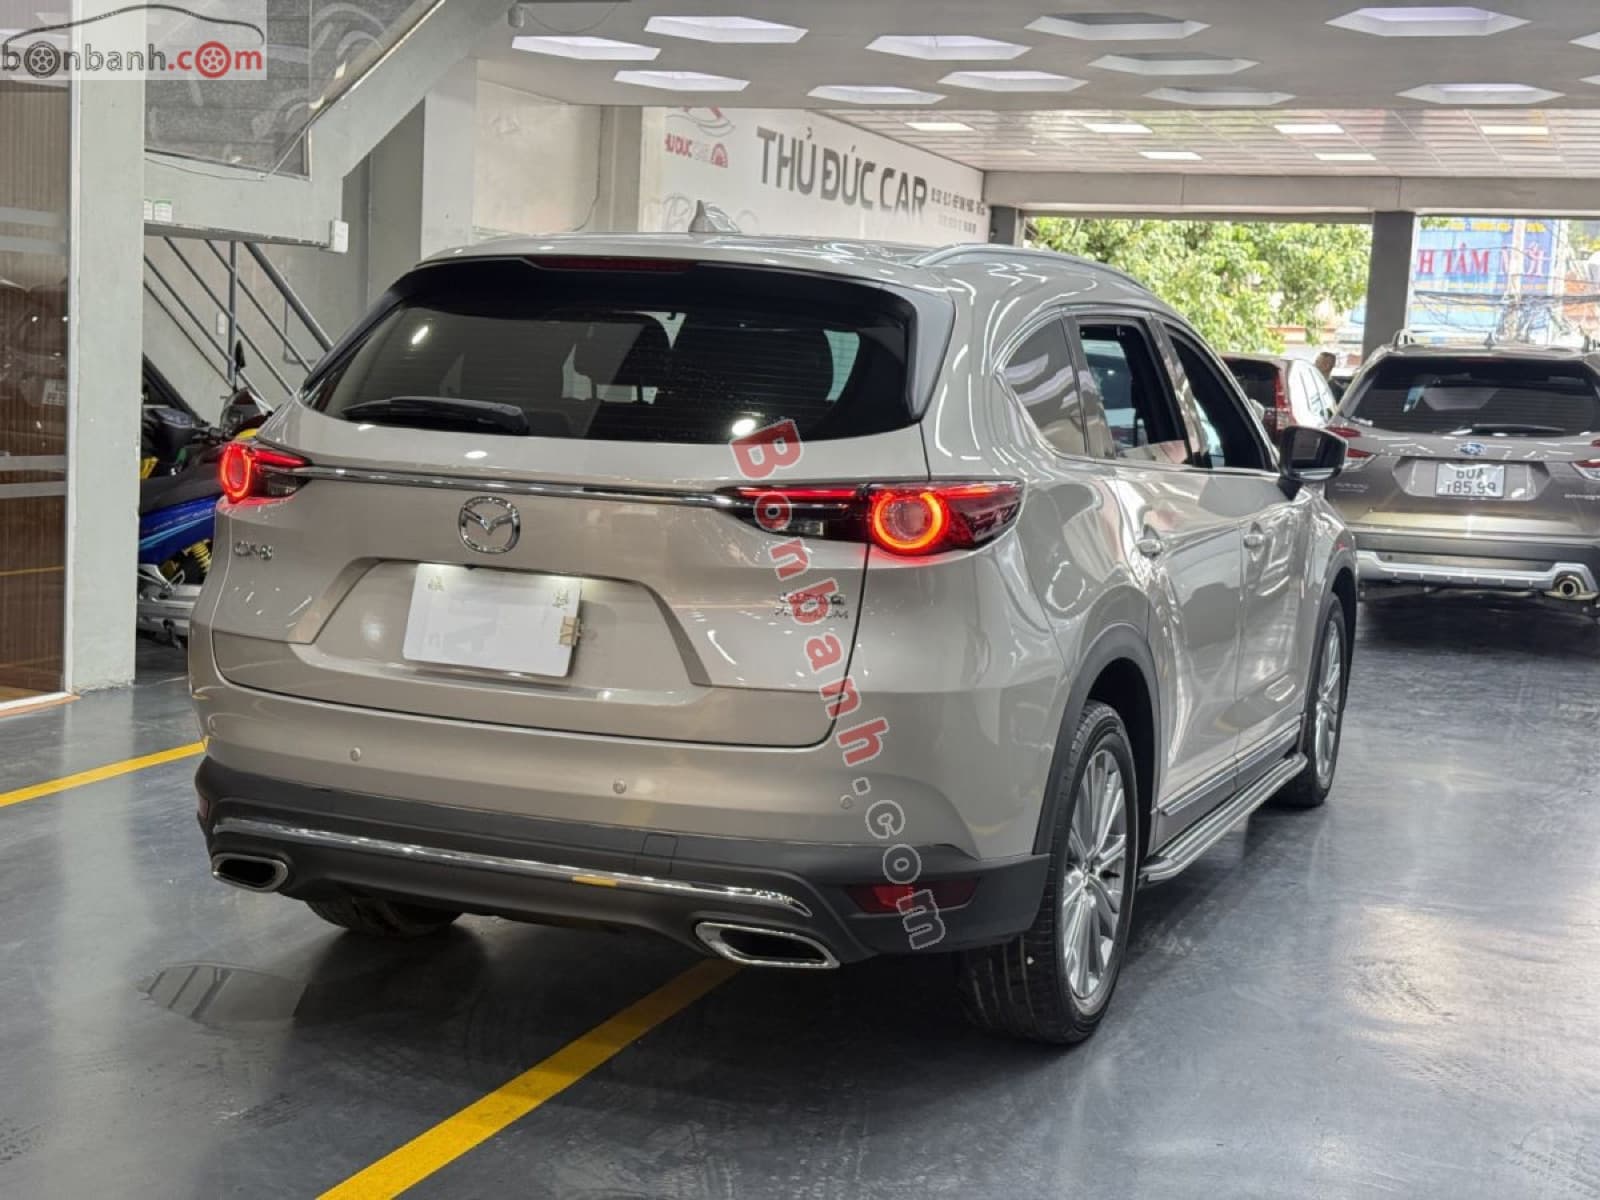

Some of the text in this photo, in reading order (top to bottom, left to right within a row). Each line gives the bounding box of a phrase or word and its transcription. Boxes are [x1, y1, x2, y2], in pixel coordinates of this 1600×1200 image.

[757, 126, 817, 195] THỦ
[820, 145, 877, 210] ĐỨC
[879, 167, 928, 216] CAR
